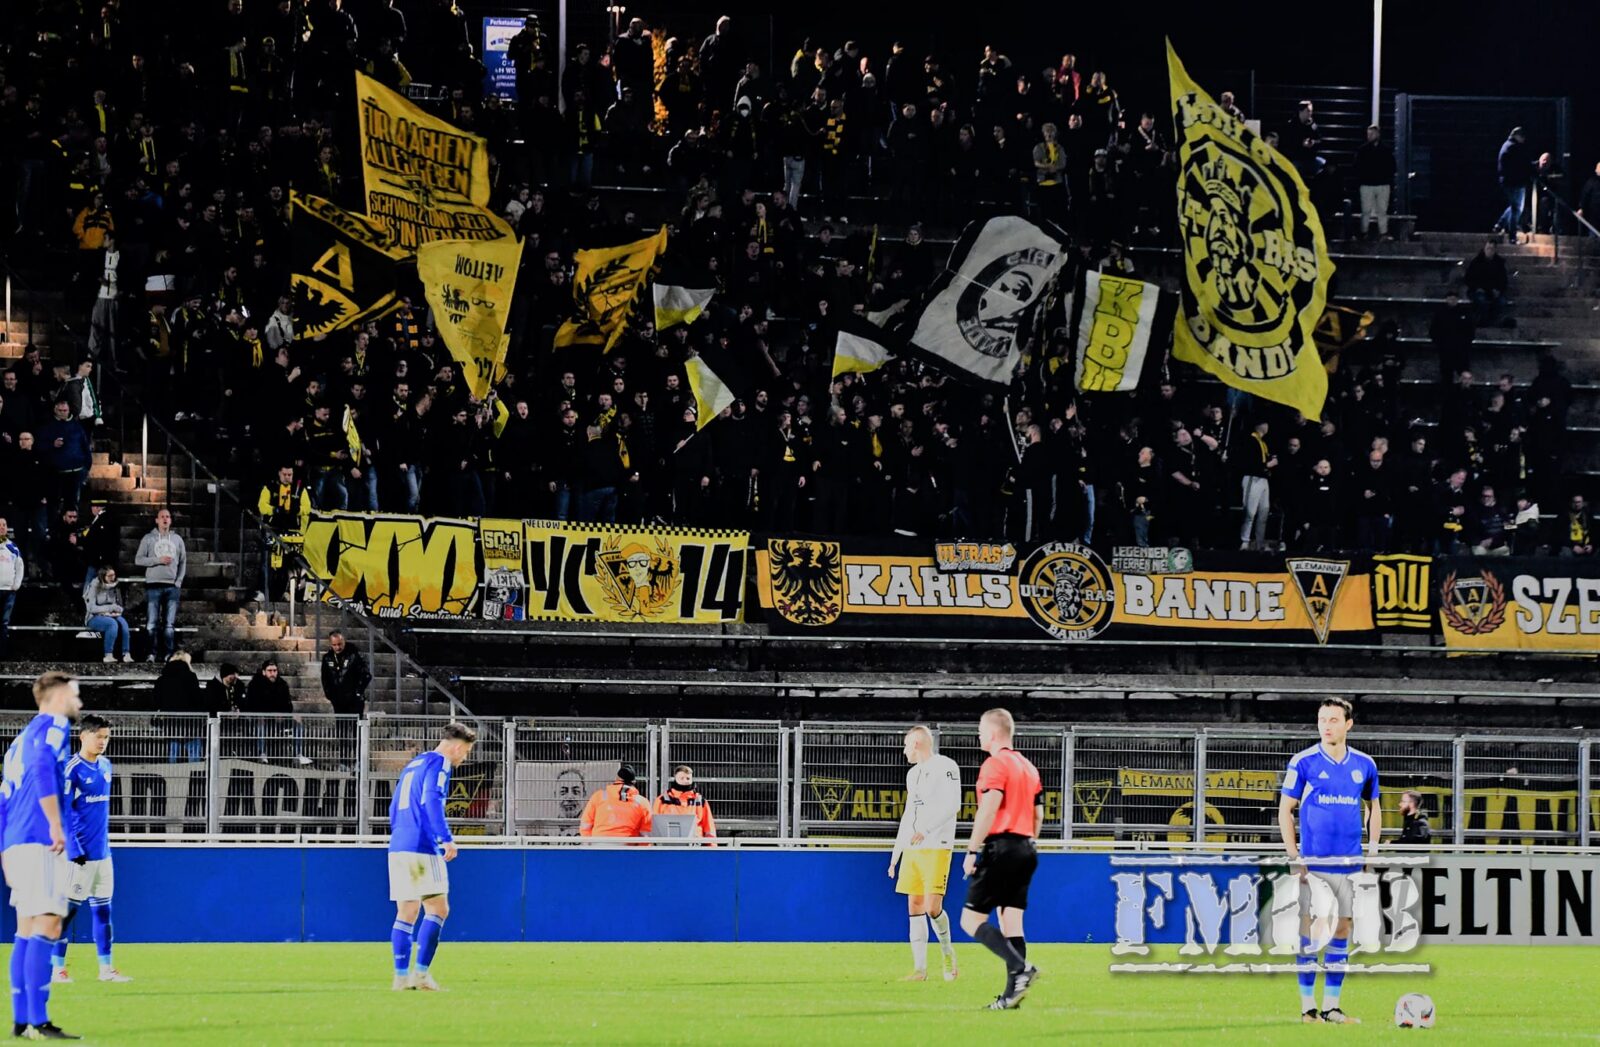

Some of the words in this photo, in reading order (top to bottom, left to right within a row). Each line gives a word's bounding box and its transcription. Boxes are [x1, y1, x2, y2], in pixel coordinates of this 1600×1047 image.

[526, 520, 560, 529] YELLOW
[1042, 543, 1092, 559] KARLS
[1112, 546, 1168, 558] LEGENDEN
[1295, 561, 1343, 572] ALEMANNIA
[680, 544, 744, 618] 14
[845, 565, 1013, 608] KARLS
[1123, 574, 1285, 621] BANDE
[1049, 623, 1096, 641] BANDE
[1123, 774, 1211, 789] ALEMANNA
